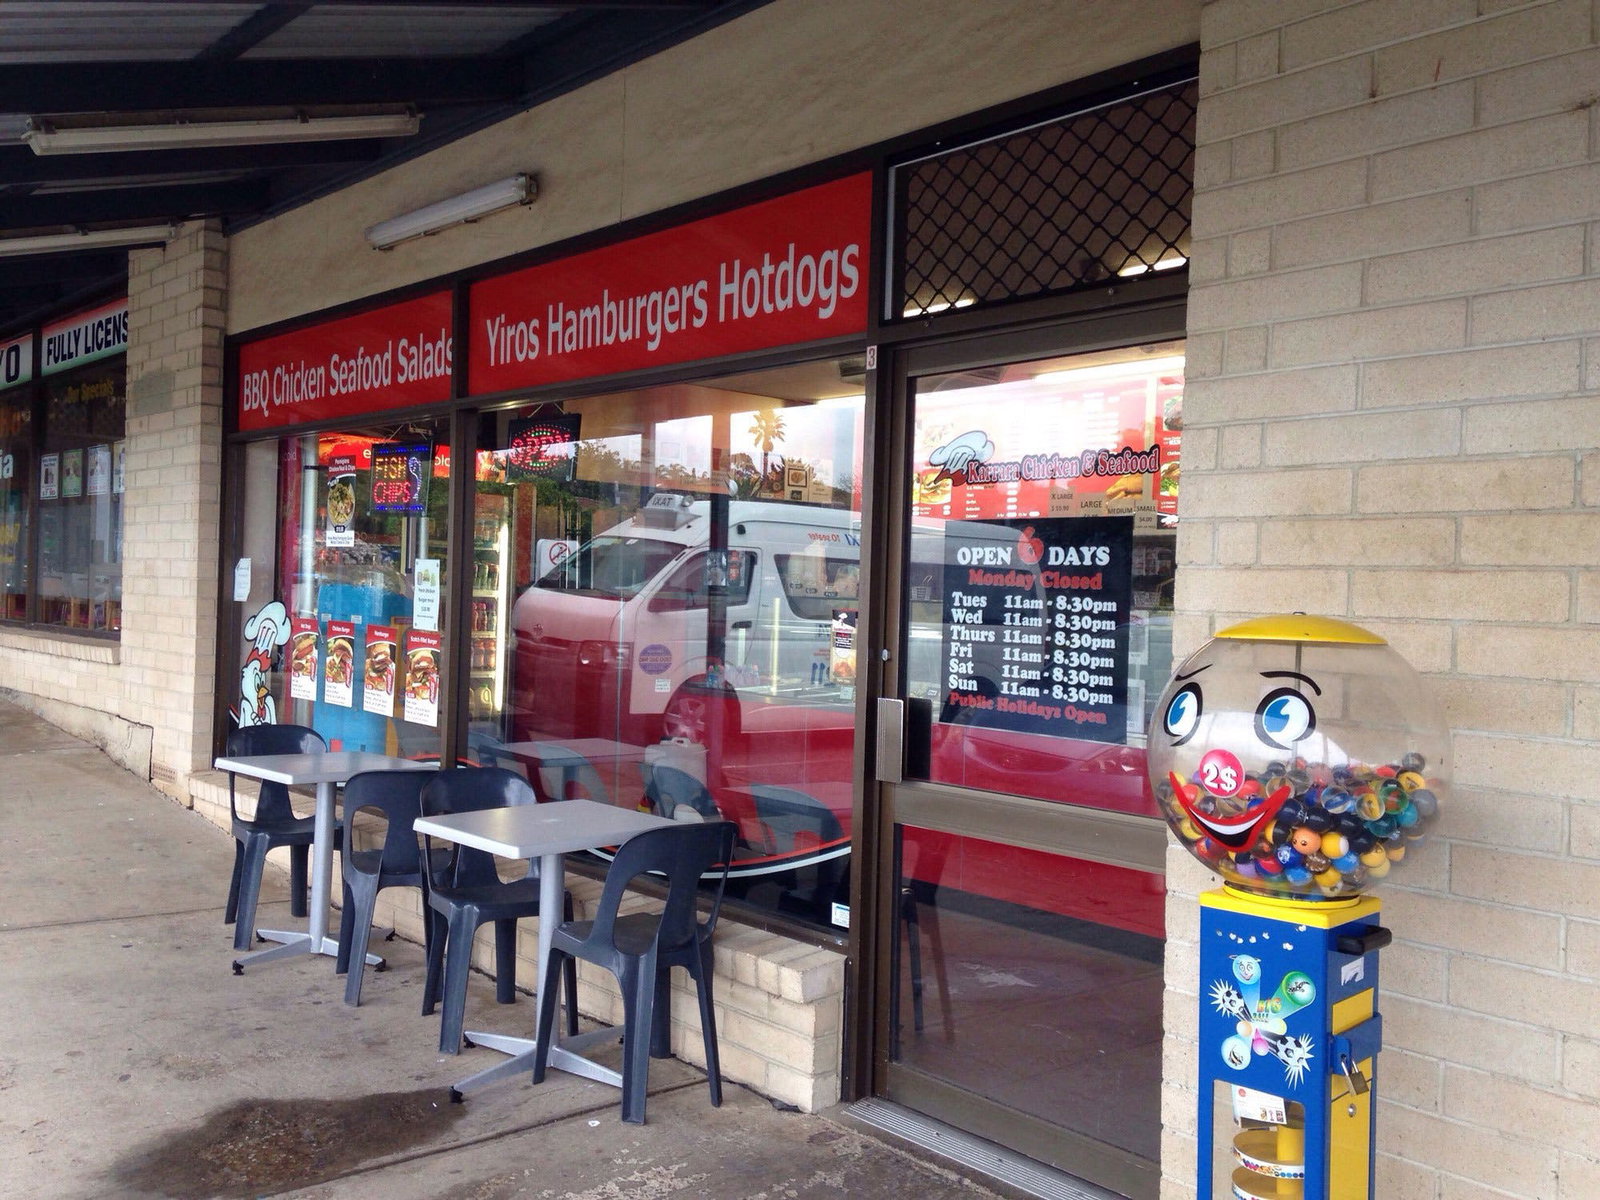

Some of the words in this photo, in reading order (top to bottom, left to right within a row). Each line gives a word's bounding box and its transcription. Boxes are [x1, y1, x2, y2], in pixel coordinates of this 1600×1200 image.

[486, 313, 540, 367] Yiros
[547, 279, 708, 352] Hamburgers
[718, 242, 860, 322] Hotdogs
[46, 327, 81, 366] FULLY
[868, 347, 876, 366] 3
[243, 369, 270, 417] BBQ
[272, 360, 326, 407] Chicken
[329, 340, 392, 396] Seafood
[397, 327, 453, 386] Salads
[375, 456, 407, 478] FISH
[967, 460, 1021, 484] Karrara
[1022, 453, 1079, 480] Chicken
[1082, 450, 1095, 477] &
[1098, 448, 1160, 476] Seafood
[373, 481, 411, 503] CHIPS
[1080, 500, 1102, 508] LARGE
[1107, 507, 1133, 515] MEDIUM
[957, 547, 1012, 565] OPEN
[1018, 526, 1044, 564] 6
[1048, 546, 1111, 566] DAYS
[968, 568, 1036, 590] Monday
[1039, 571, 1103, 590] Closed
[952, 591, 987, 608] Tues
[1004, 595, 1043, 610] 11am
[1055, 595, 1117, 614] 8.30pm
[951, 609, 983, 625] Wed
[1003, 613, 1042, 628] 11am
[1055, 613, 1116, 631] 8.30pm
[950, 625, 996, 642] Thurs
[1003, 630, 1042, 645] 11am
[1054, 631, 1116, 650] 8.30pm
[950, 642, 973, 658] Fri
[1003, 648, 1042, 663] 11am
[1053, 650, 1114, 669] 8.30pm
[949, 659, 974, 674] Sat
[1002, 665, 1041, 680] 11am
[1052, 667, 1114, 687] 8.30pm
[949, 675, 978, 691] Sun
[1001, 682, 1040, 698] 11am
[1052, 685, 1114, 705] 8.30pm
[950, 691, 993, 709] Public
[997, 698, 1062, 719] Holidays
[1064, 705, 1107, 724] Open
[1202, 762, 1238, 792] 2$
